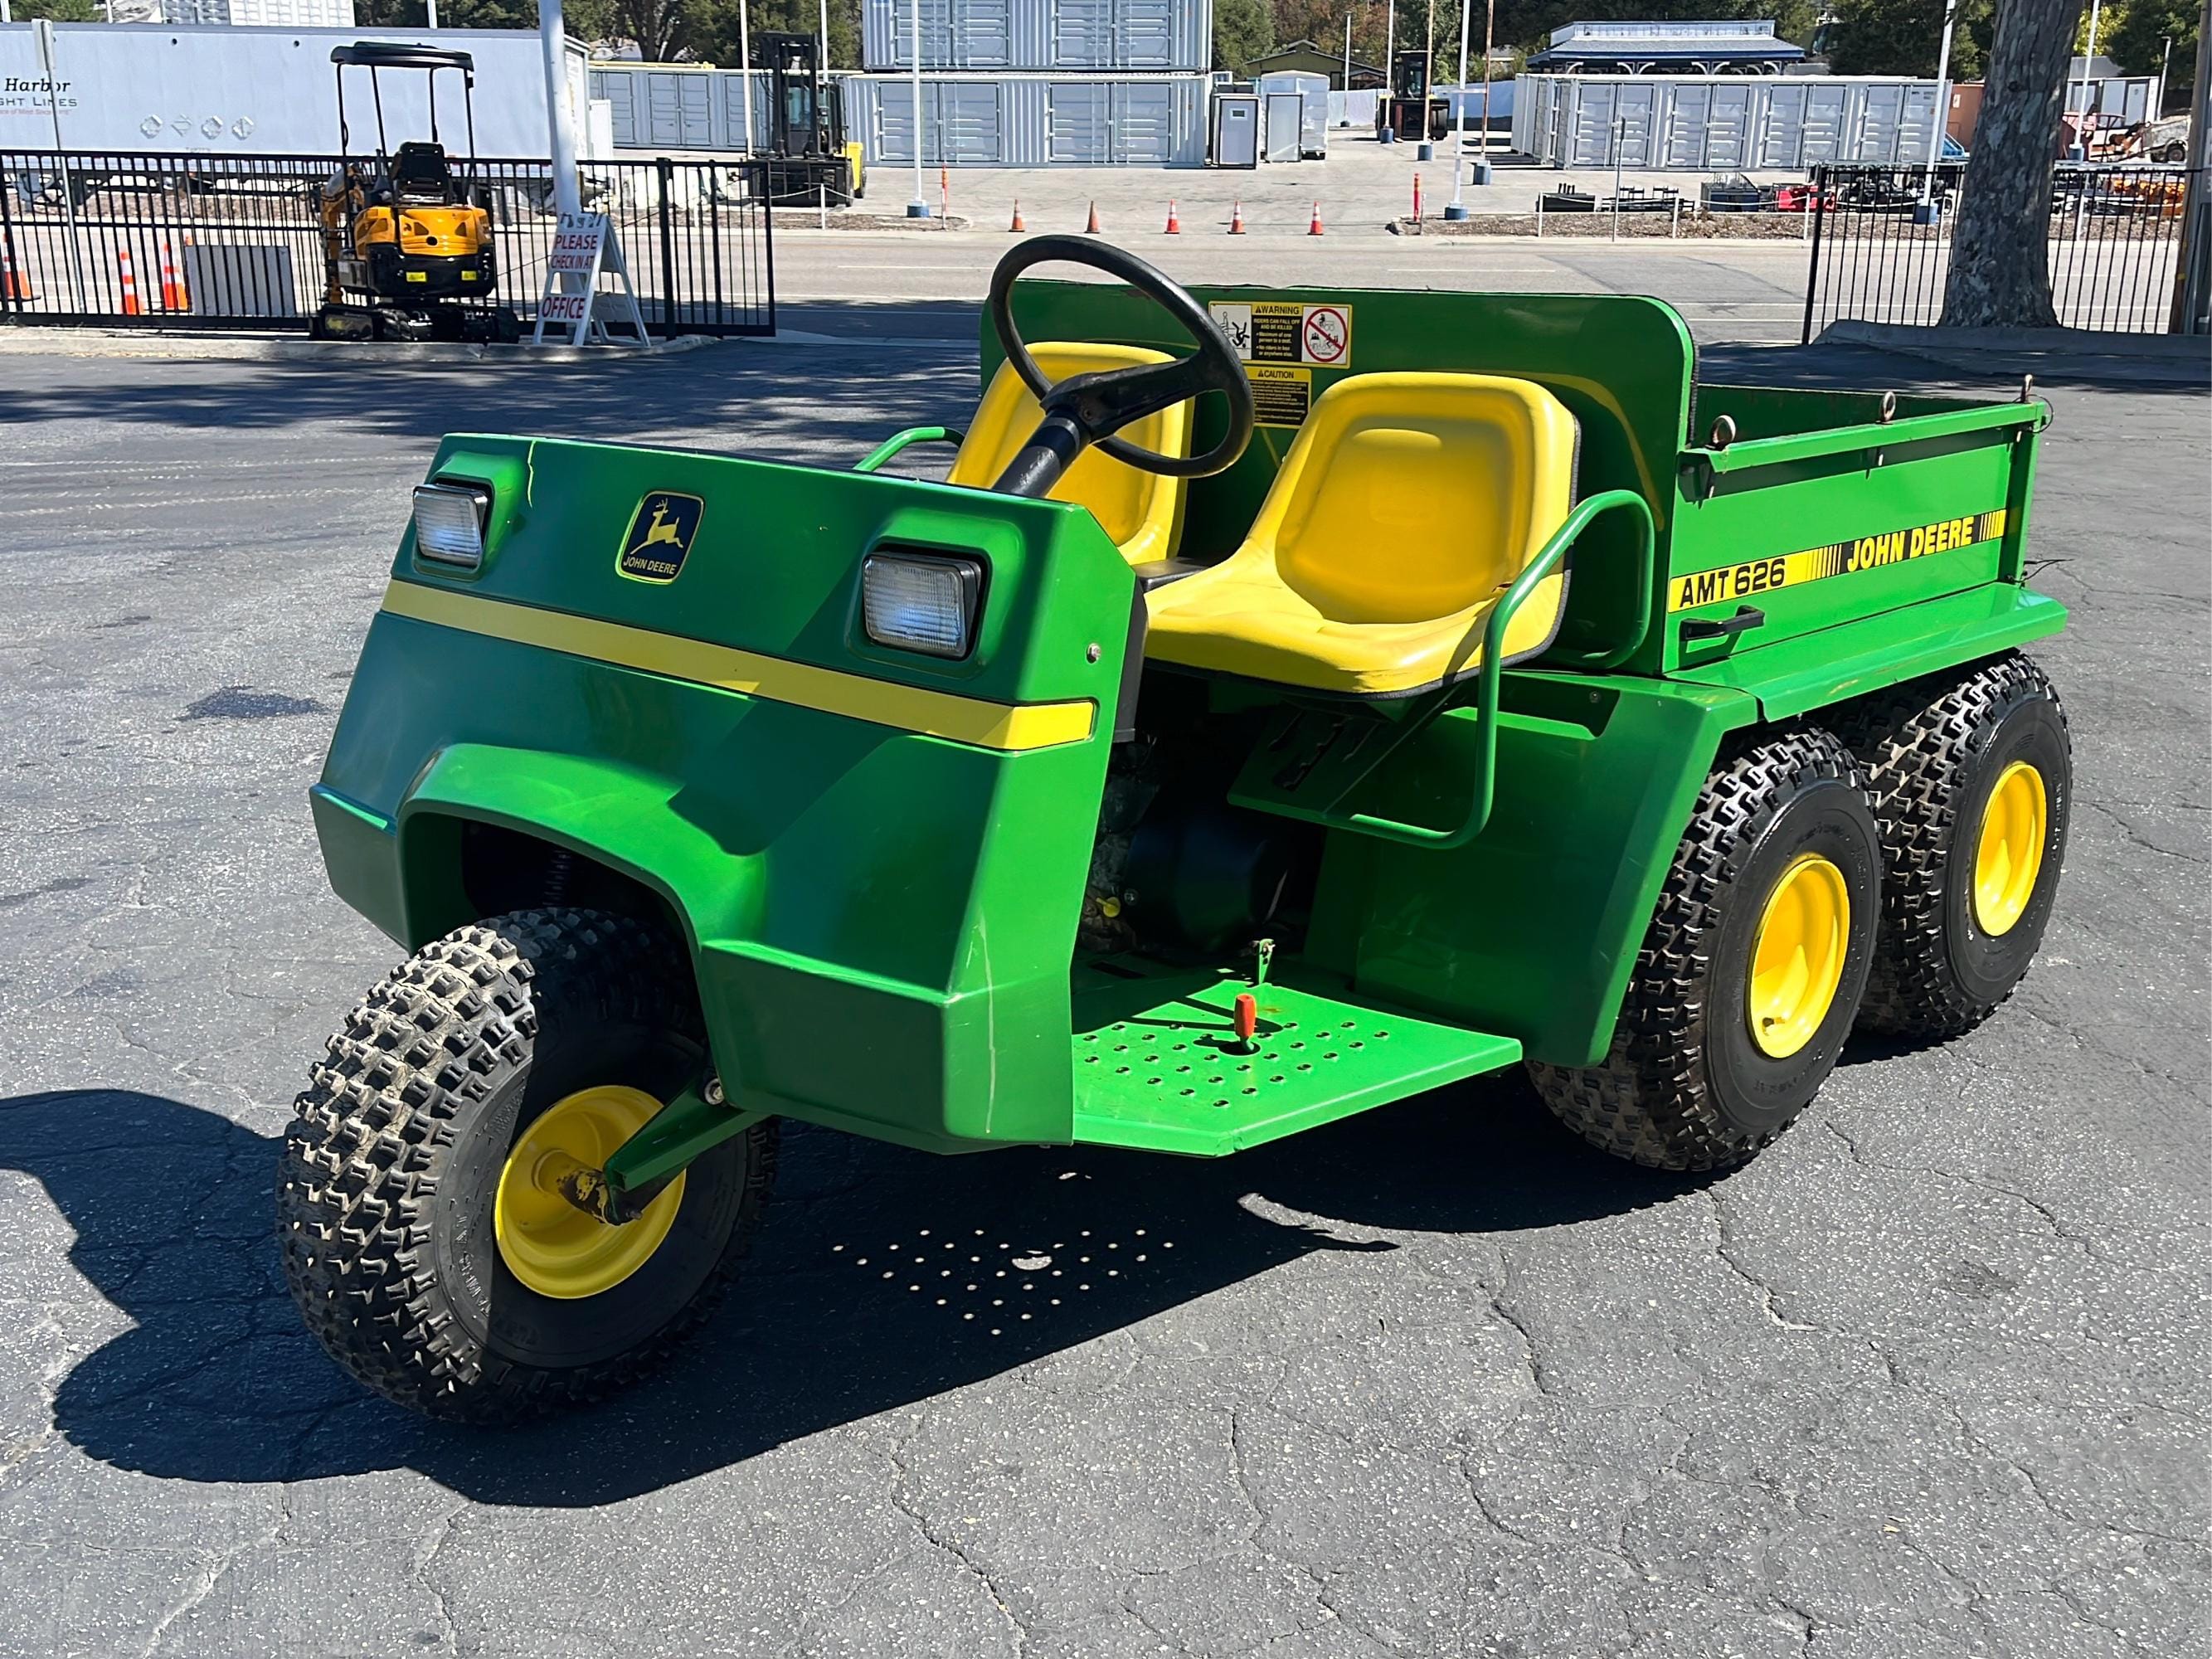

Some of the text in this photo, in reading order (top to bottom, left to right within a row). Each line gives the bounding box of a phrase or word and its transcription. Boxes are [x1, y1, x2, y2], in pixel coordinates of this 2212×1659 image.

[554, 235, 598, 250] PLEASE
[551, 255, 596, 269] CHECK IN AT
[542, 296, 586, 319] OFFICE
[1260, 305, 1300, 315] WARNING
[1264, 370, 1295, 379] CAUTION
[623, 557, 677, 574] JOHN DEERE
[1680, 516, 1975, 608] AMT 626 JOHN DEERE
